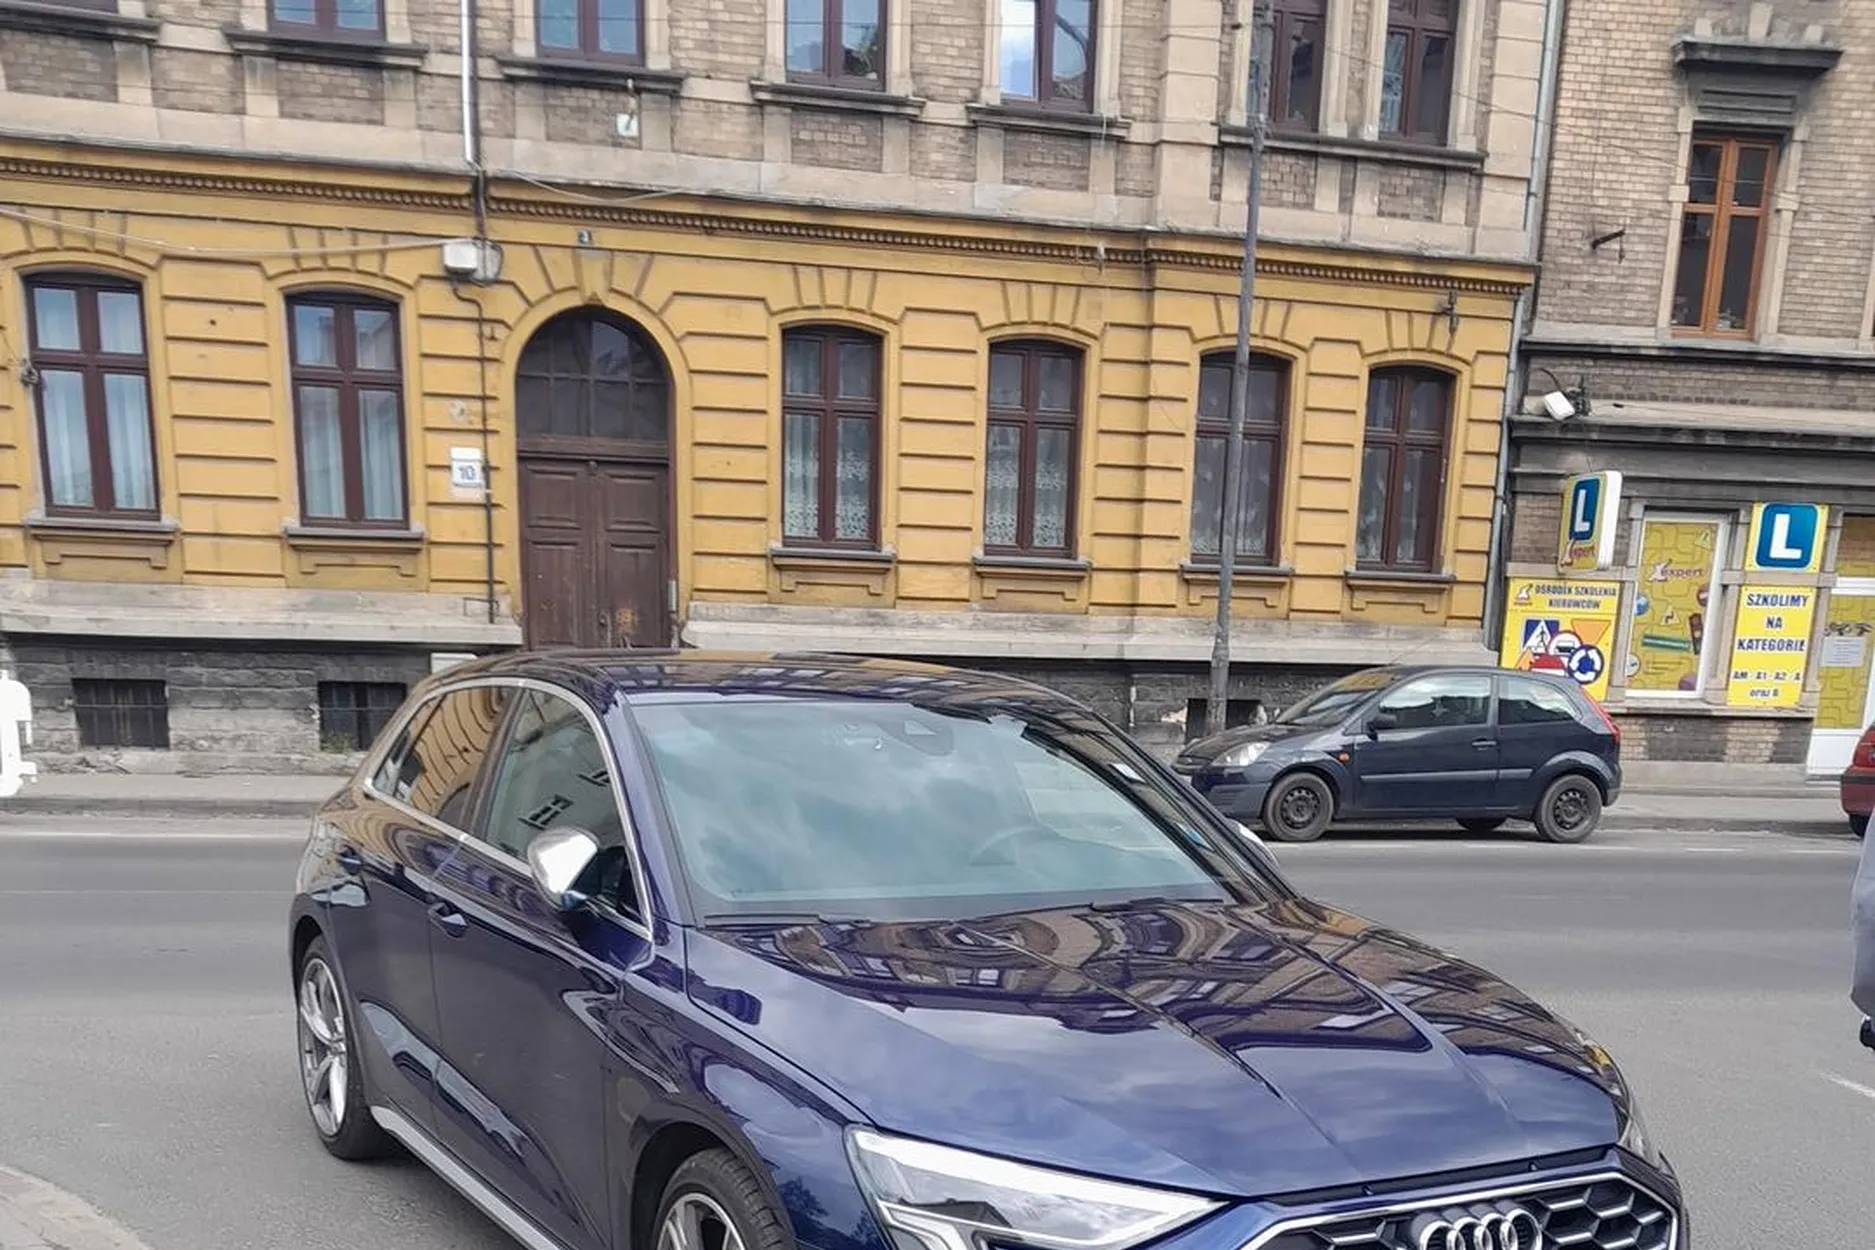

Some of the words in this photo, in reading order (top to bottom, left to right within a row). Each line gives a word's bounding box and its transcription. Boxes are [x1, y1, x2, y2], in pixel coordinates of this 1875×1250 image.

[1574, 488, 1591, 532] L
[1769, 512, 1803, 559] L
[1746, 593, 1809, 607] SZKOLIMY
[1765, 616, 1783, 629] NA
[1736, 638, 1806, 652] KATEGORIE
